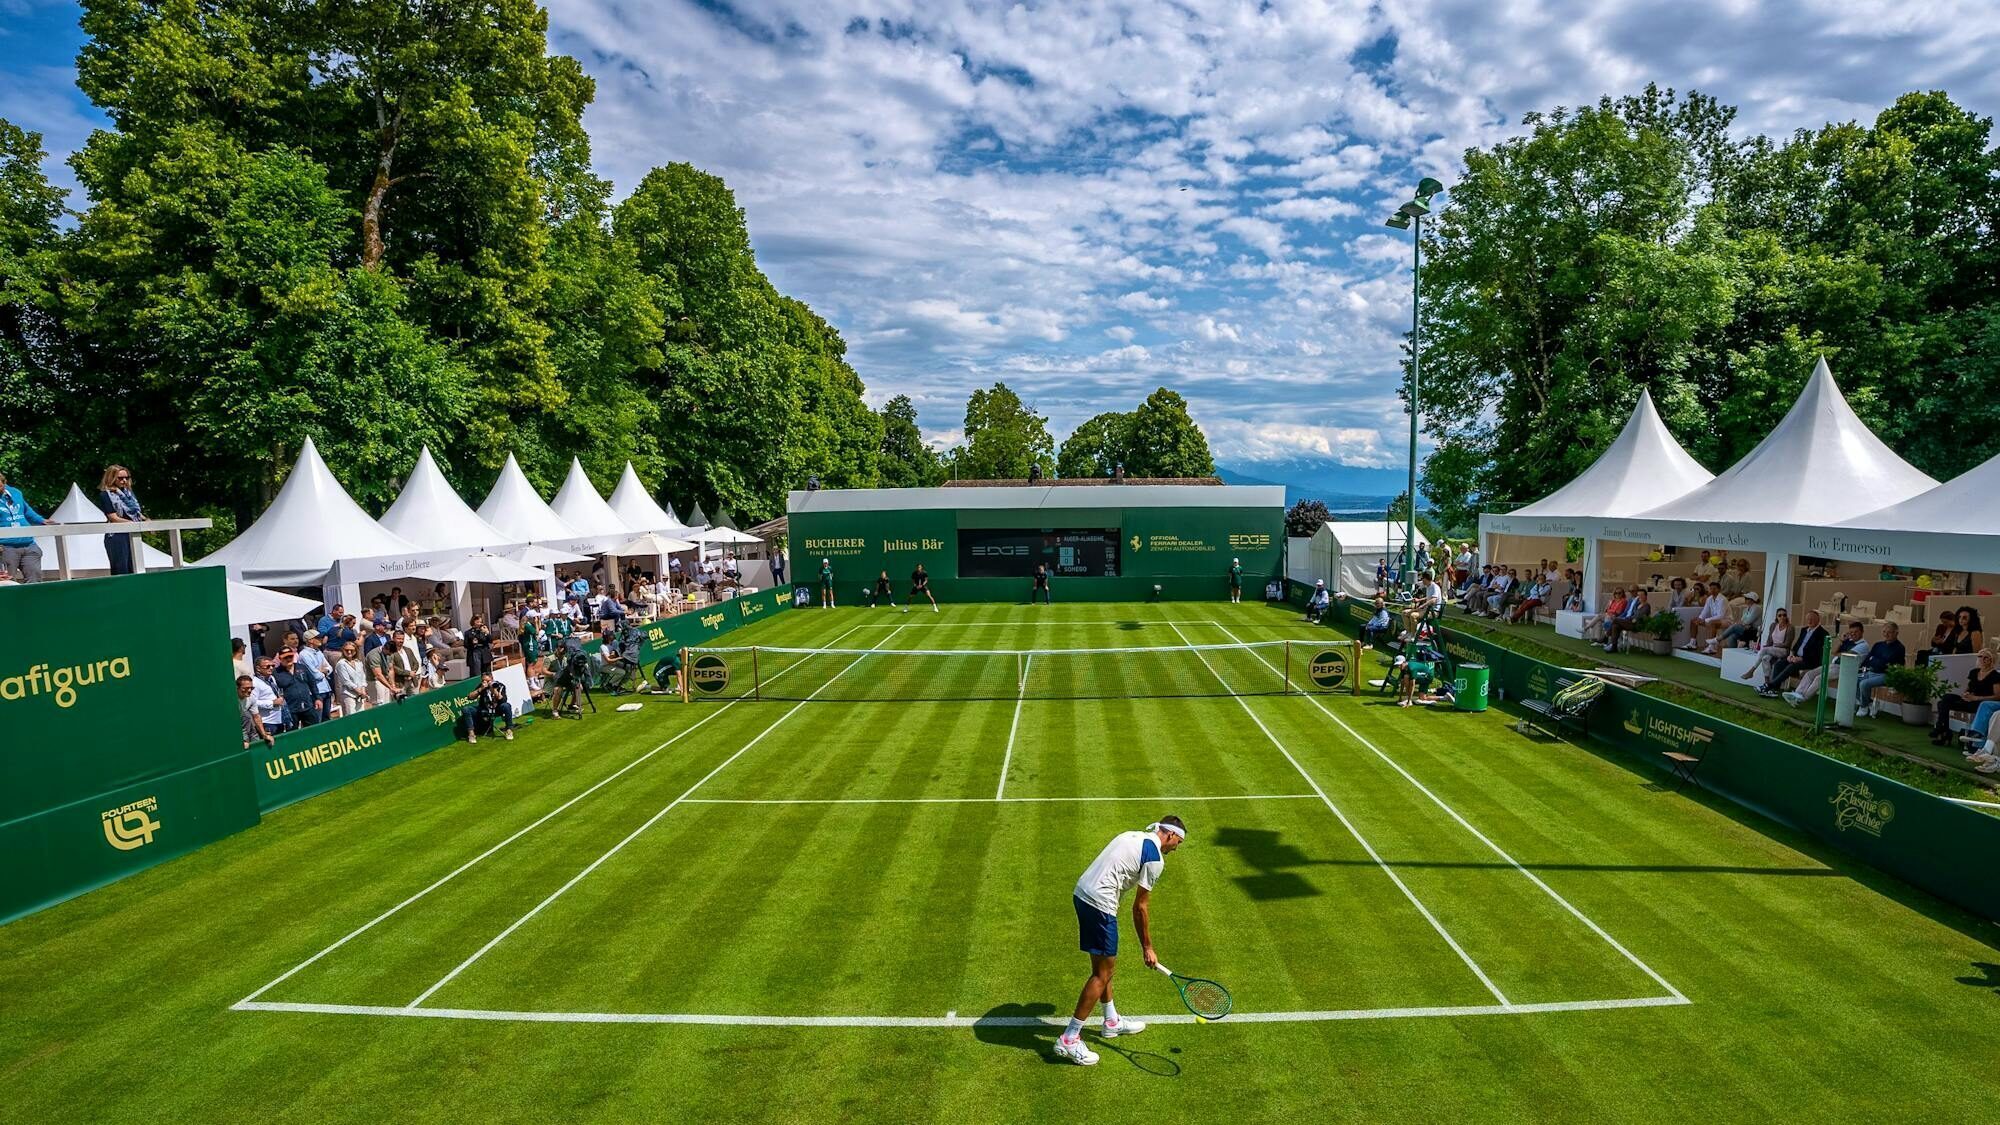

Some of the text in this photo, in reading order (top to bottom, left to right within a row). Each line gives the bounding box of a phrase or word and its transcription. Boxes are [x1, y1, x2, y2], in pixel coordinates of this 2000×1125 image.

[805, 539, 865, 548] BUCHERER
[884, 538, 944, 552] Julius Bär
[1697, 531, 1750, 546] Arthur Ashe
[1808, 535, 1891, 556] Roy Ermerson
[380, 559, 431, 572] Stefan Edberg
[701, 613, 724, 630] Trafigura
[649, 627, 664, 641] GPA
[693, 670, 727, 679] PEPSI
[1312, 665, 1345, 673] PEPSI
[265, 728, 382, 779] ULTIMEDIA.CH
[102, 796, 157, 820] FOURTEEN
